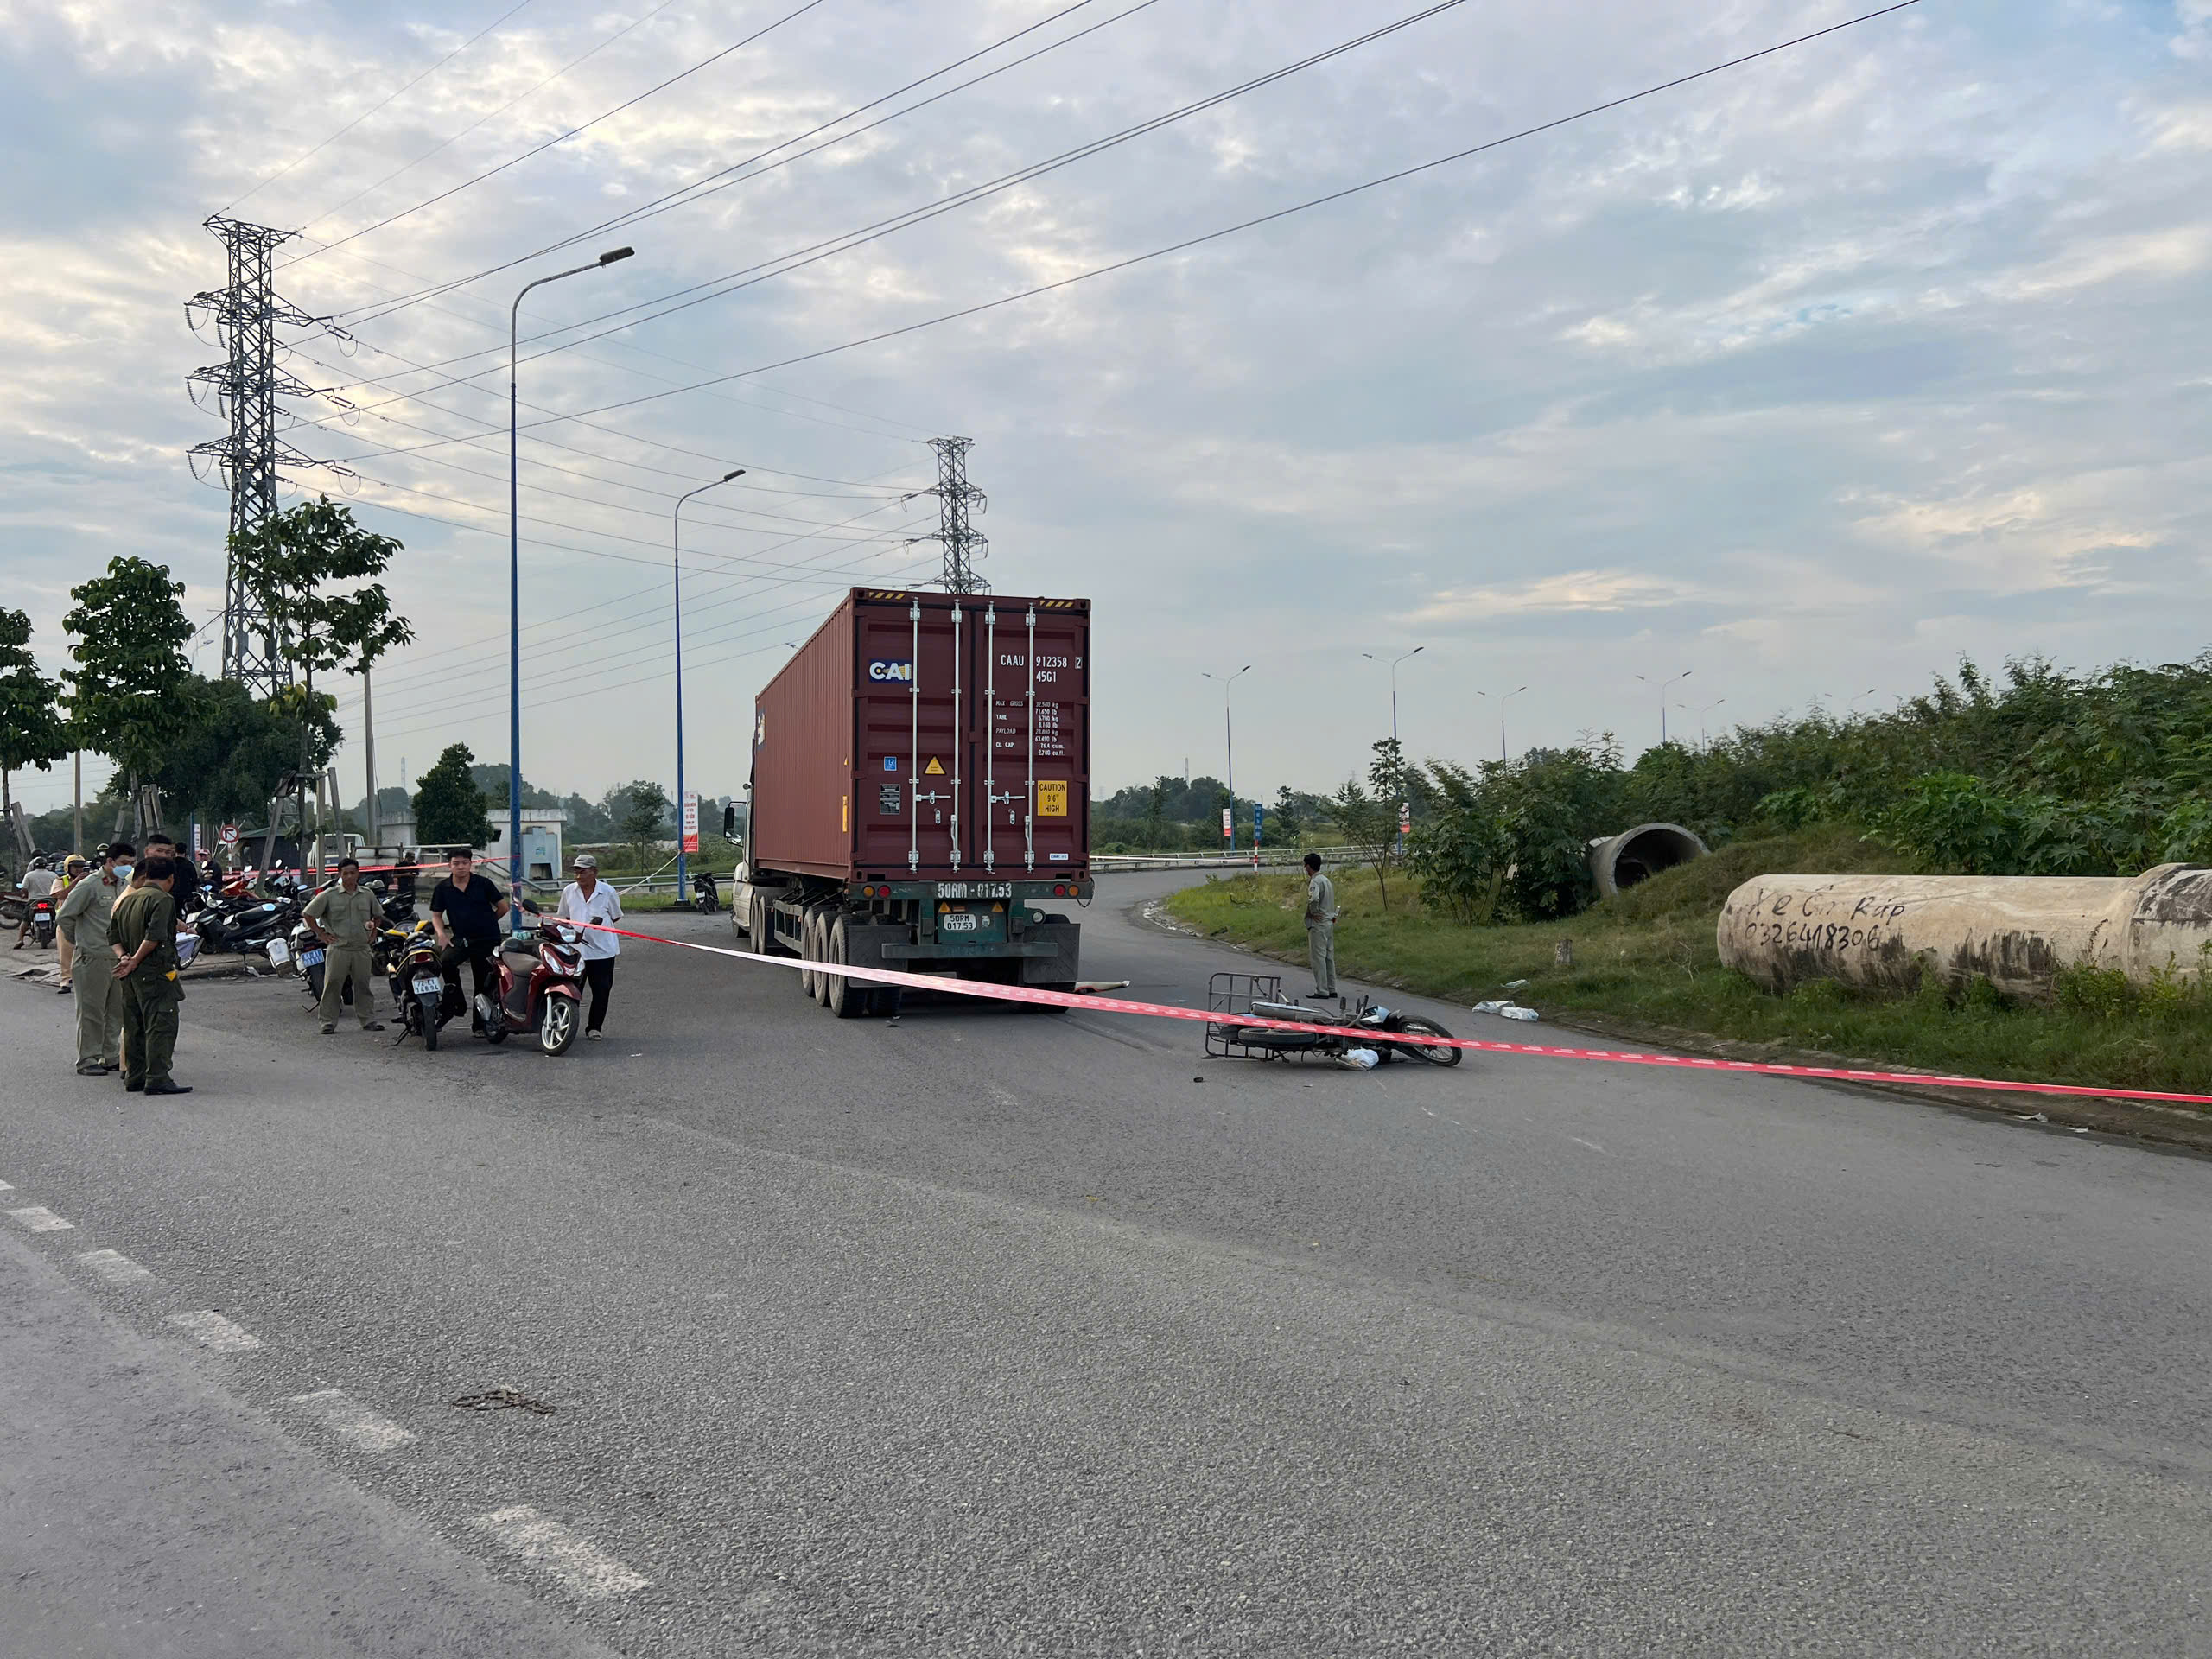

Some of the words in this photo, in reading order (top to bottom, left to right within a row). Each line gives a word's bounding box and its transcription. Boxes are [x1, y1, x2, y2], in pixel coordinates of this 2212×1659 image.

[1001, 654, 1025, 666] CAAU
[1036, 656, 1067, 668] 912358
[1075, 657, 1082, 669] 2
[869, 662, 910, 681] CAI
[1036, 671, 1057, 683] 45G1
[1039, 783, 1066, 792] CAUTION
[1045, 804, 1060, 813] HIGH
[938, 882, 968, 899] 50RM
